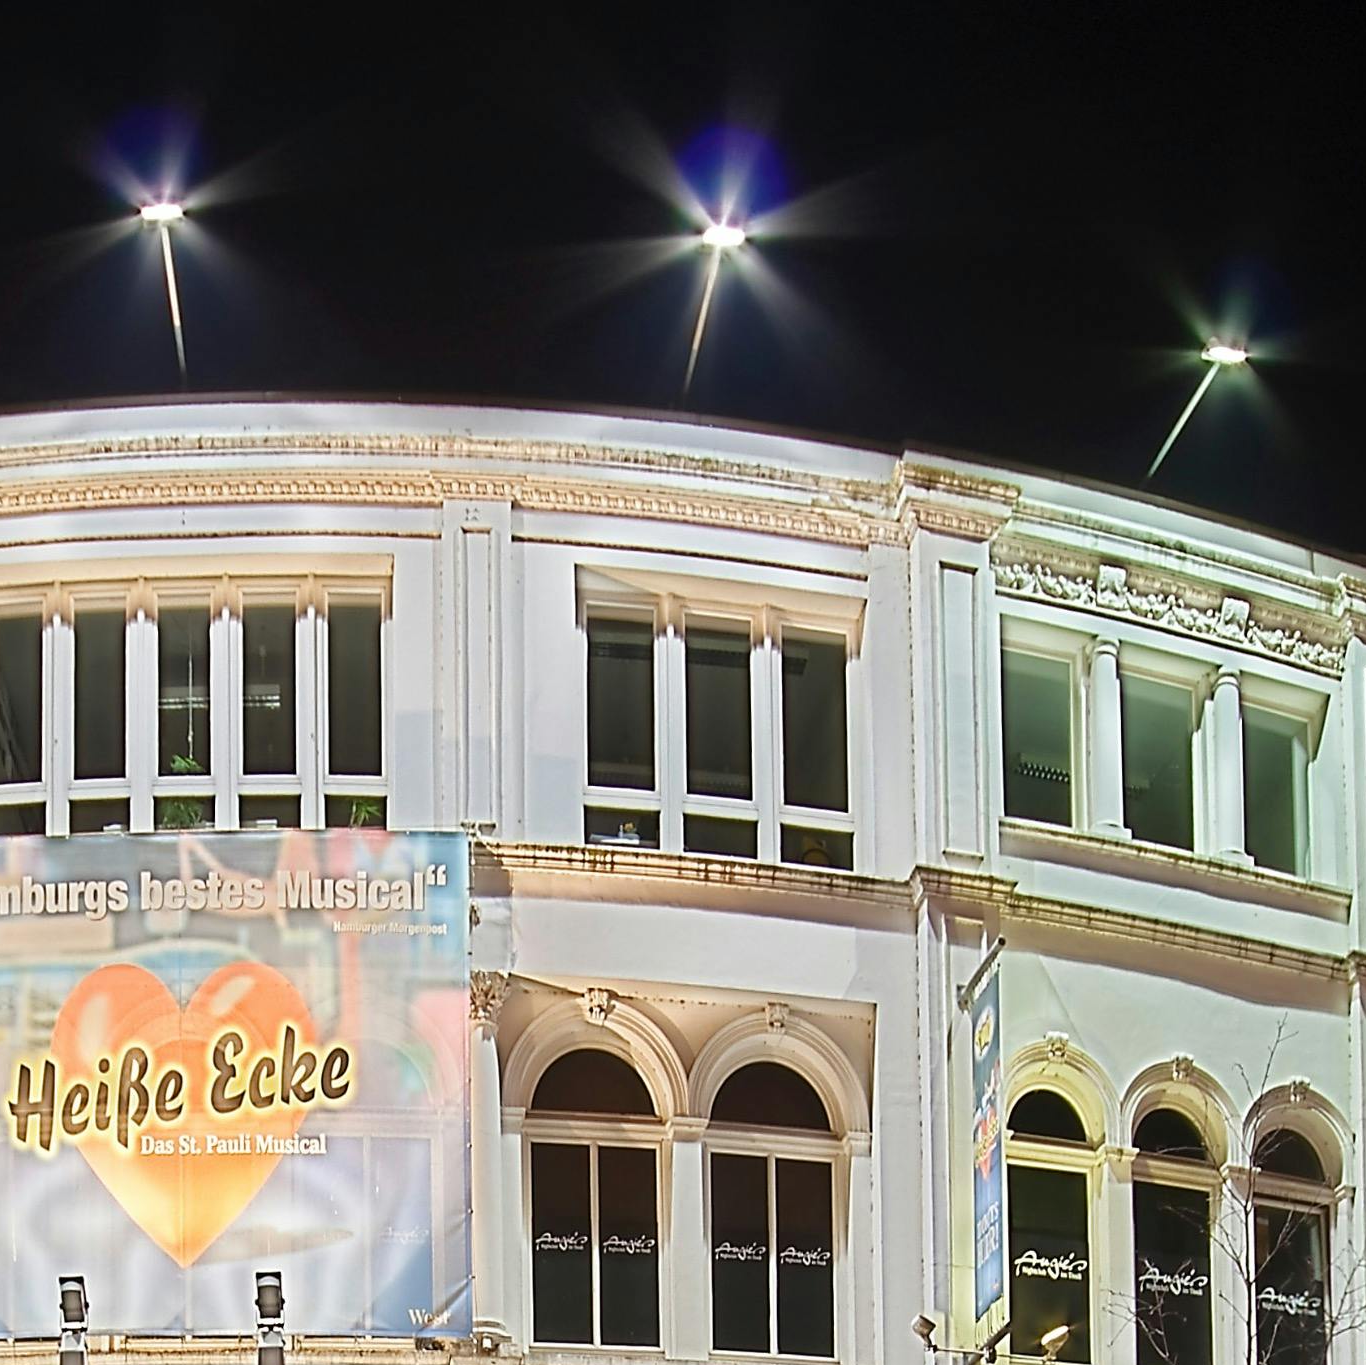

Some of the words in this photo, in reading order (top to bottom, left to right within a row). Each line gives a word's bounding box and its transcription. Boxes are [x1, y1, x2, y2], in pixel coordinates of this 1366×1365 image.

[140, 871, 265, 912] bestes
[278, 865, 446, 912] Musical“
[333, 921, 388, 936] Hamburger
[390, 922, 447, 936] Morgenpost
[9, 1046, 184, 1151] Heiße
[211, 1025, 350, 1114] Ecke
[140, 1135, 175, 1155] Das
[179, 1135, 201, 1156] St.
[207, 1134, 250, 1155] Pauli
[256, 1133, 326, 1155] Musical
[408, 1308, 451, 1325] West
